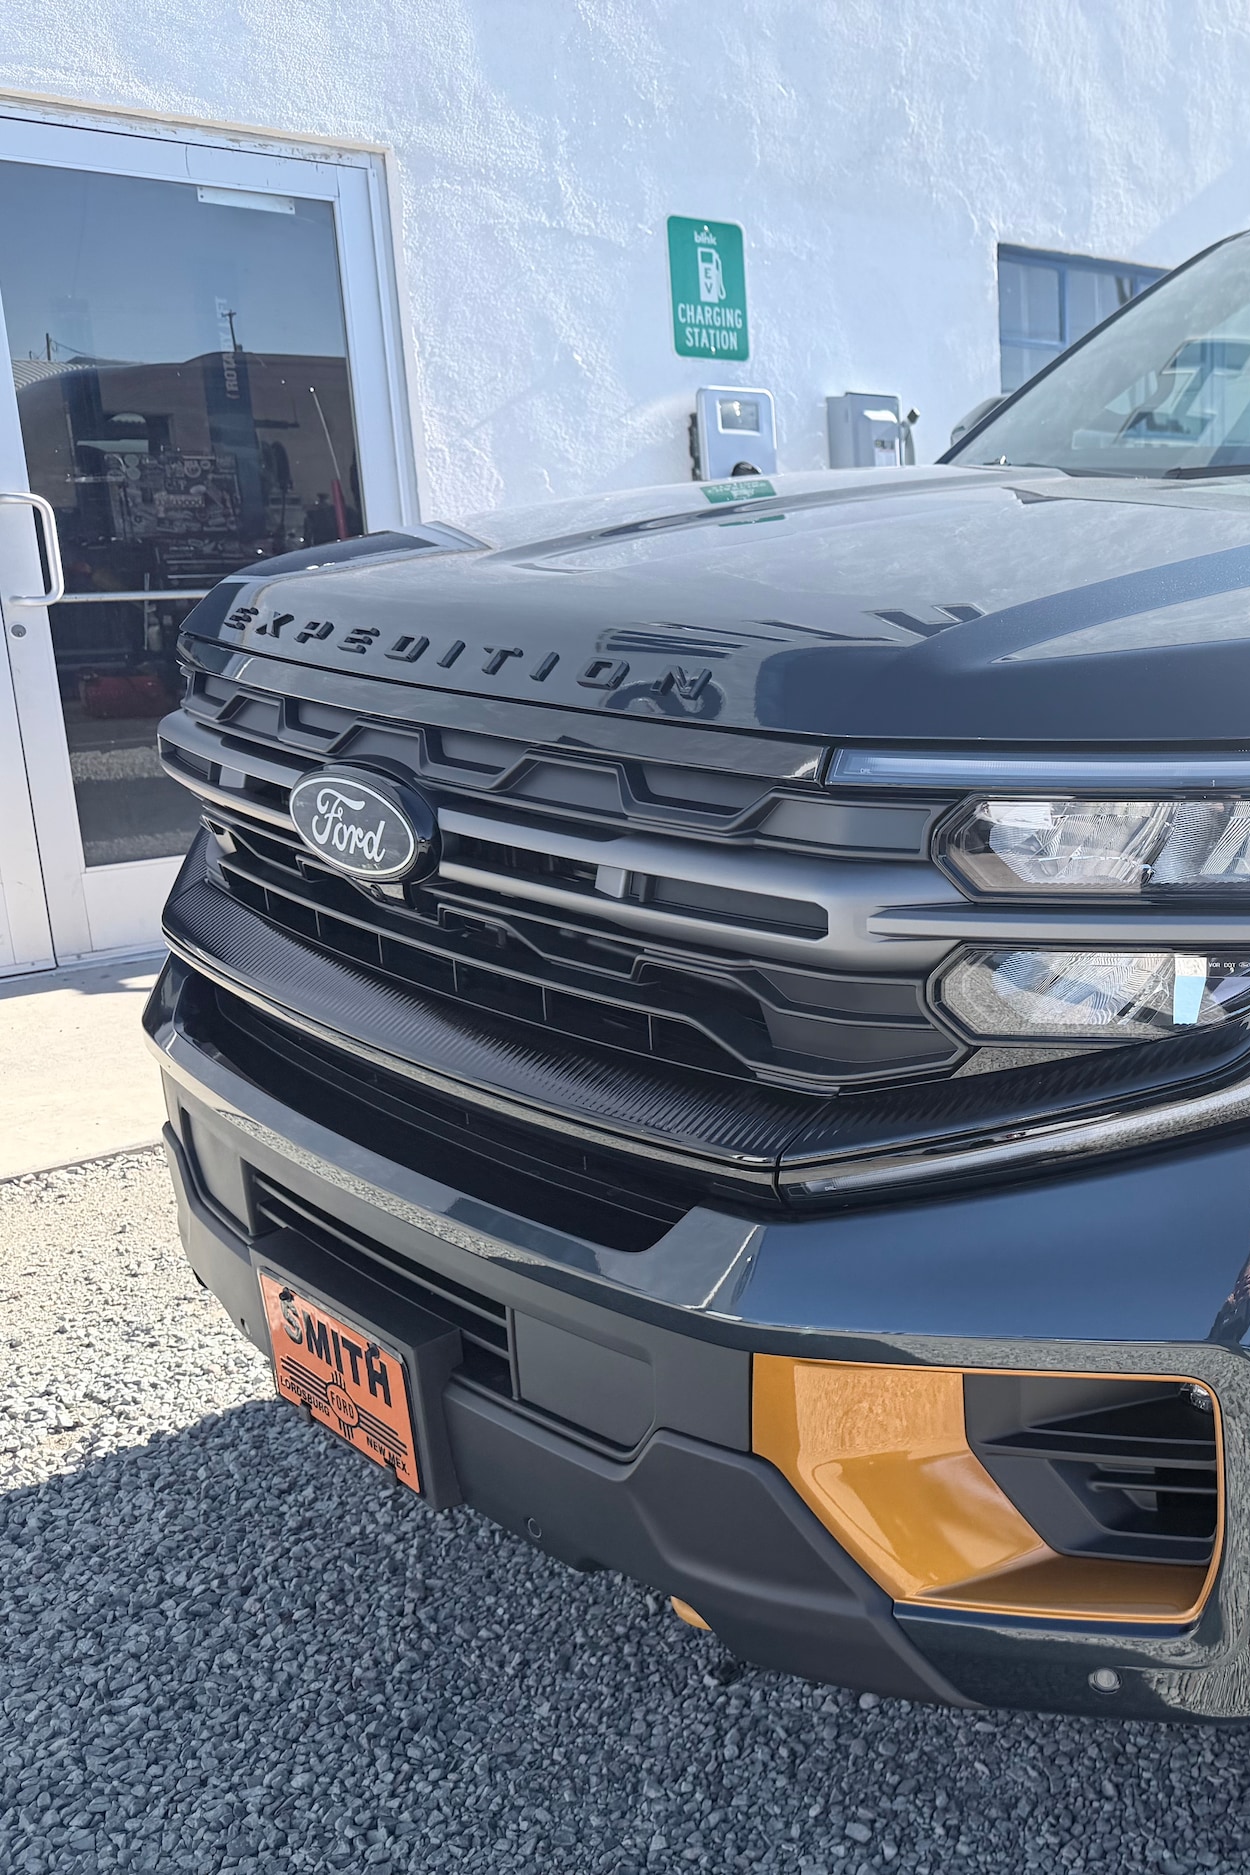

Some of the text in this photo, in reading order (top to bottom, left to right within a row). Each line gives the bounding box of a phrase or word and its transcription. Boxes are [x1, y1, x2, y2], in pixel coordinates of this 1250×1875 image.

[678, 303, 743, 329] CHARGING
[685, 327, 738, 351] STATION
[223, 606, 714, 701] EXPEDITION
[311, 787, 387, 864] Ford
[280, 1297, 392, 1408] SMITH
[279, 1374, 330, 1418] LORDSBURG
[366, 1436, 386, 1460] NEW
[330, 1390, 356, 1420] FORD
